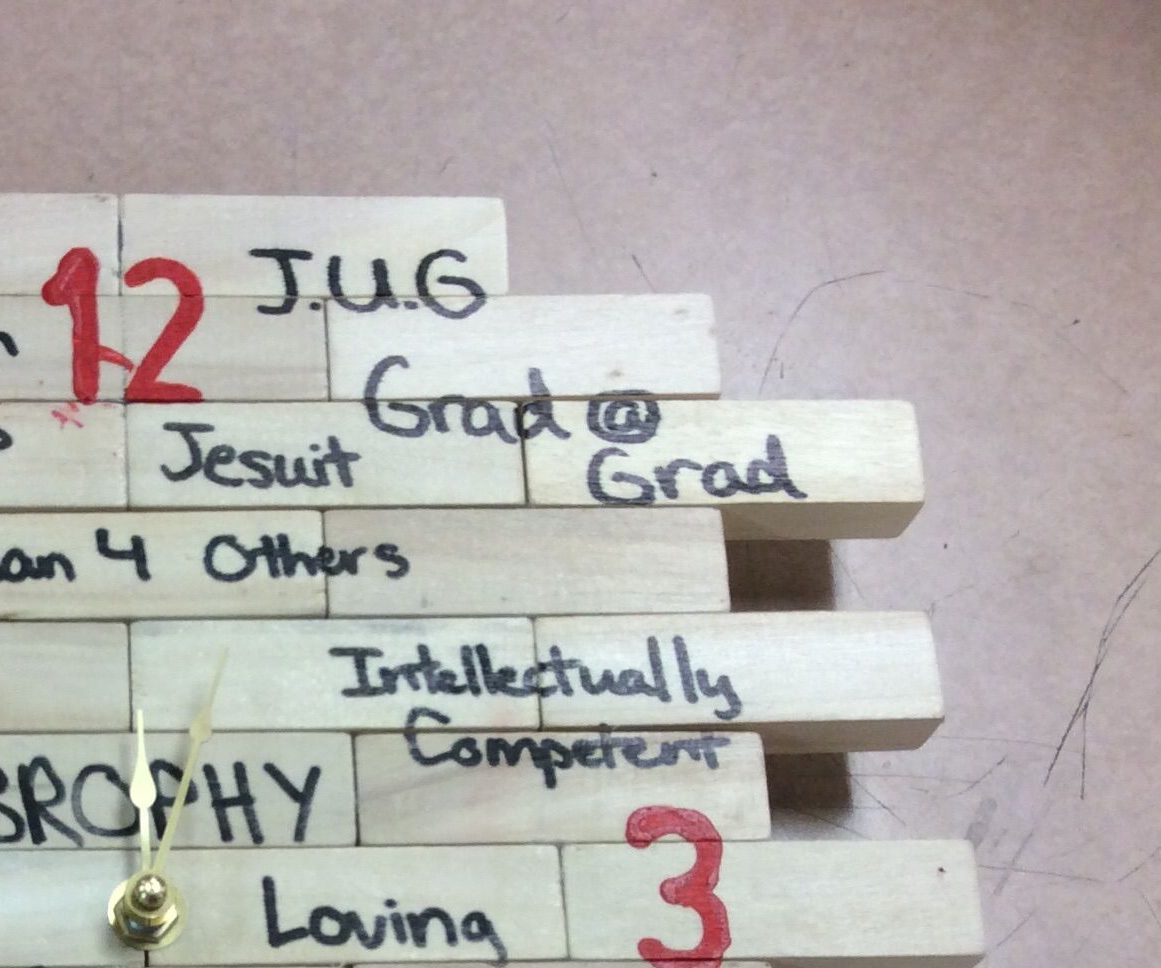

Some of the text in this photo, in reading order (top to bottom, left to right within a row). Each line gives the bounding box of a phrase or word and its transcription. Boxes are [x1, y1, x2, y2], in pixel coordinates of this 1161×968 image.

[41, 246, 205, 404] 12
[361, 355, 661, 443] Grad @
[160, 420, 361, 490] Jesuit
[587, 433, 808, 506] Grad
[95, 526, 151, 582] 4
[203, 532, 411, 582] Others
[329, 635, 742, 721] Intellectually
[402, 707, 730, 790] Competent
[262, 875, 510, 964] Loving
